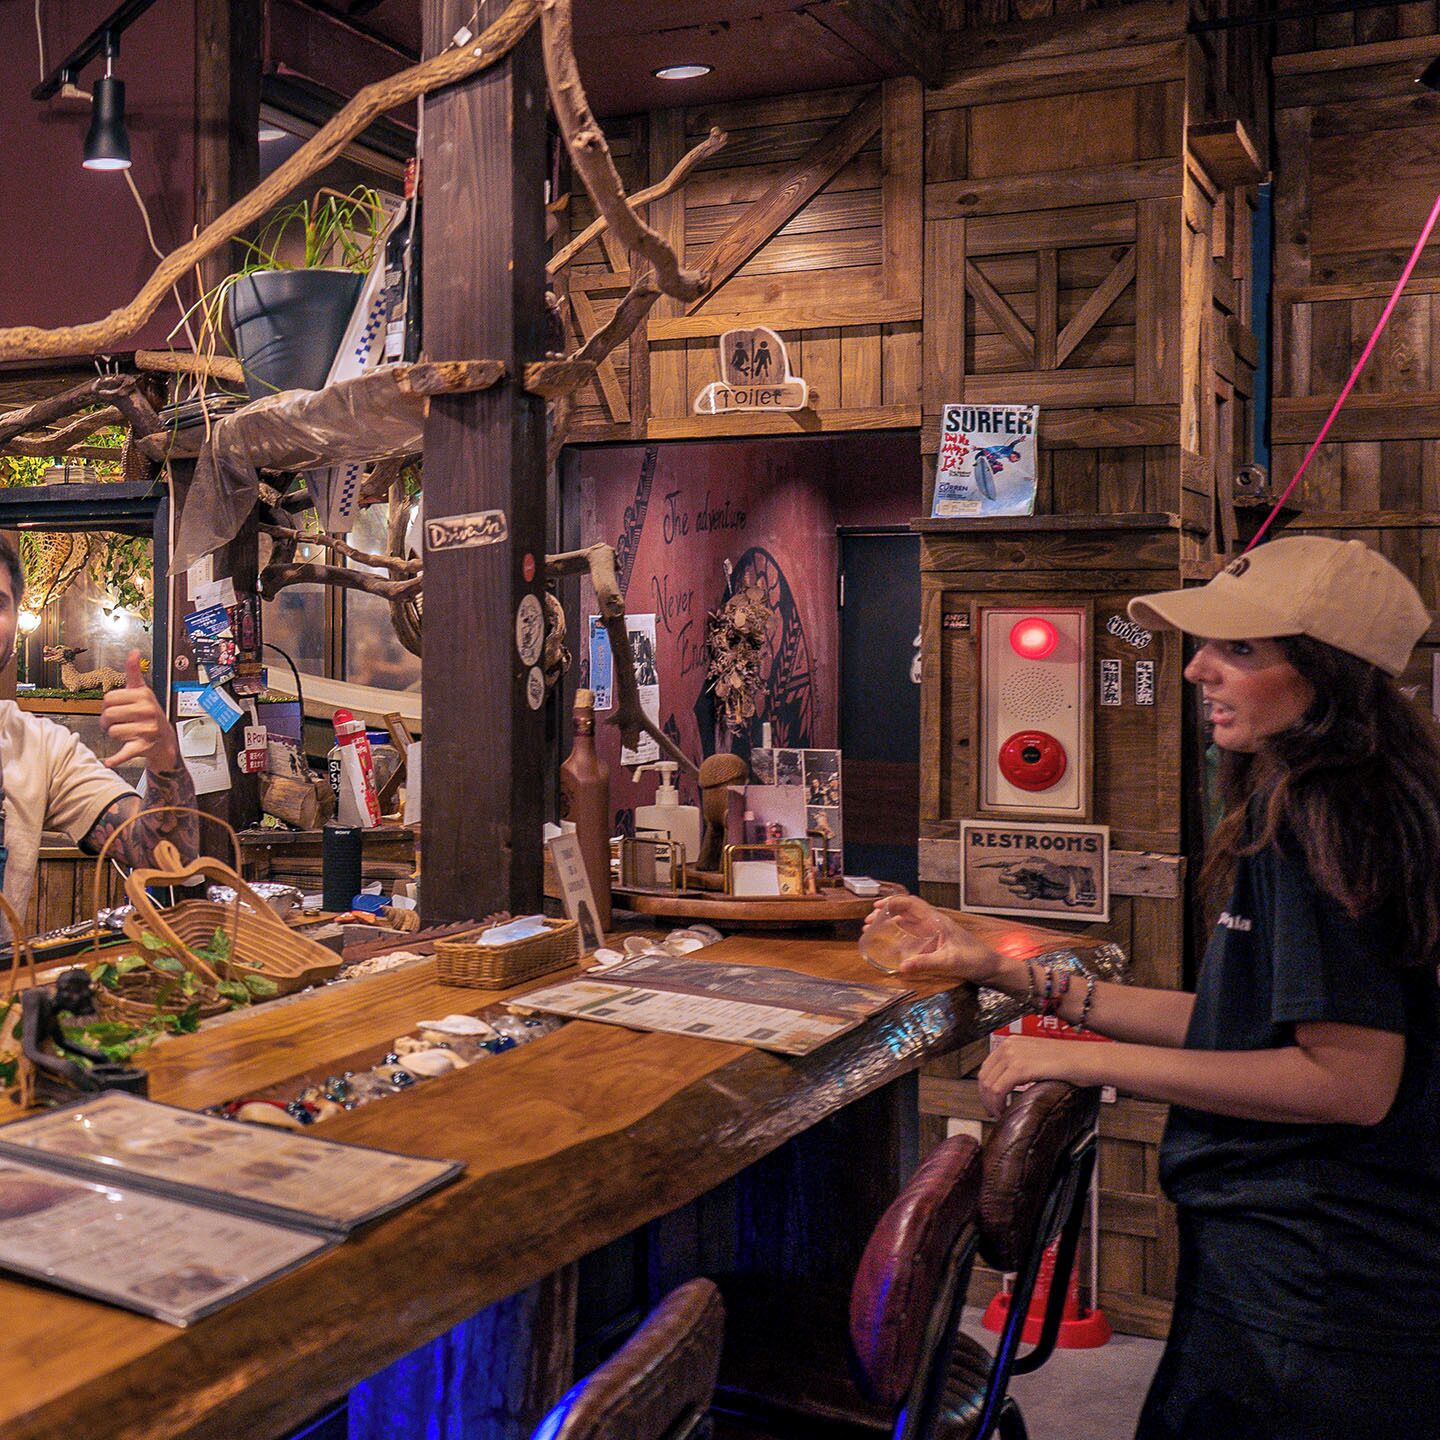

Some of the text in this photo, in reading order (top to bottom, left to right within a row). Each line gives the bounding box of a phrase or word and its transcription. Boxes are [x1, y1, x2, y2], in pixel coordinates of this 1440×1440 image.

[717, 389, 782, 409] Toilet
[945, 410, 1033, 434] SURFER
[696, 491, 747, 532] adventure
[651, 574, 694, 633] Never
[972, 833, 1097, 853] RESTROOMS
